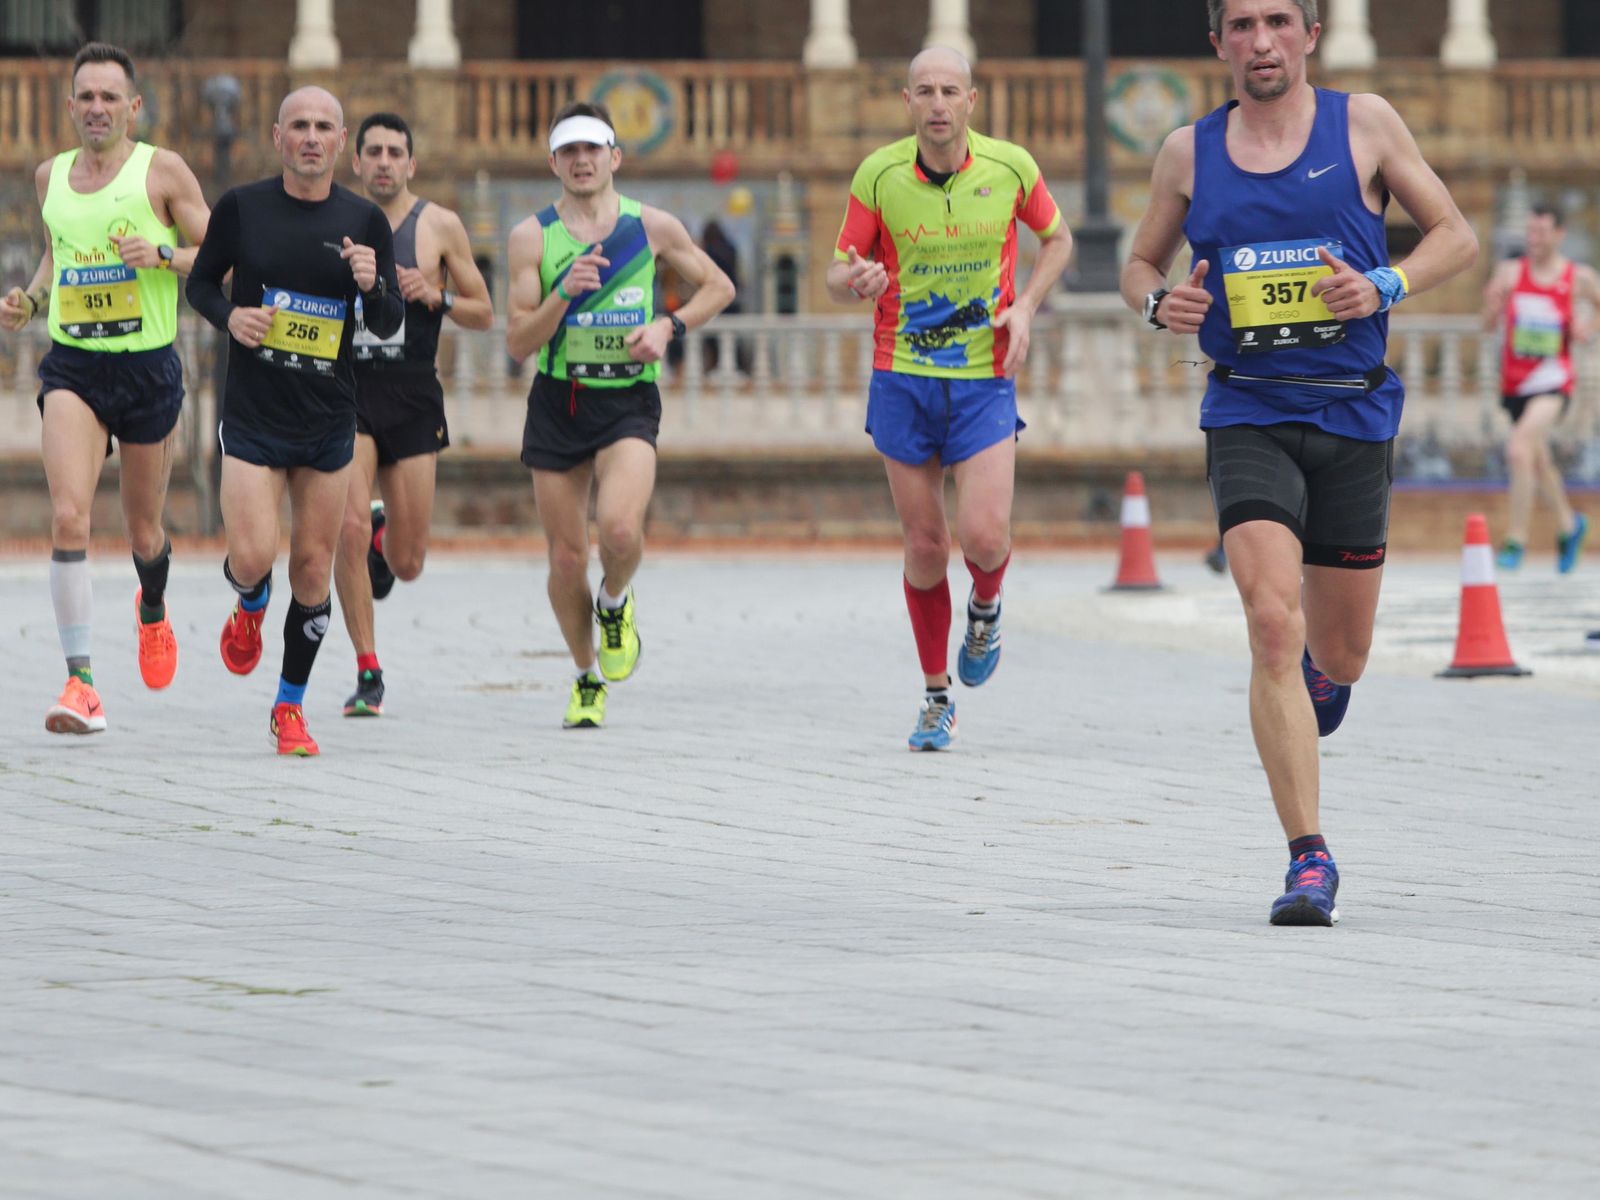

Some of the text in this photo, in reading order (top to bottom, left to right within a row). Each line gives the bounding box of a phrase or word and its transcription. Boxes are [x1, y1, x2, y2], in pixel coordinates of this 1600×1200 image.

[81, 268, 126, 283] ZURICH
[83, 291, 113, 309] 351
[1261, 281, 1308, 306] 357
[293, 298, 339, 317] ZURICH
[1269, 310, 1300, 320] DIEGO
[595, 312, 639, 324] ZURICH
[286, 321, 320, 342] 256
[594, 335, 625, 350] 523
